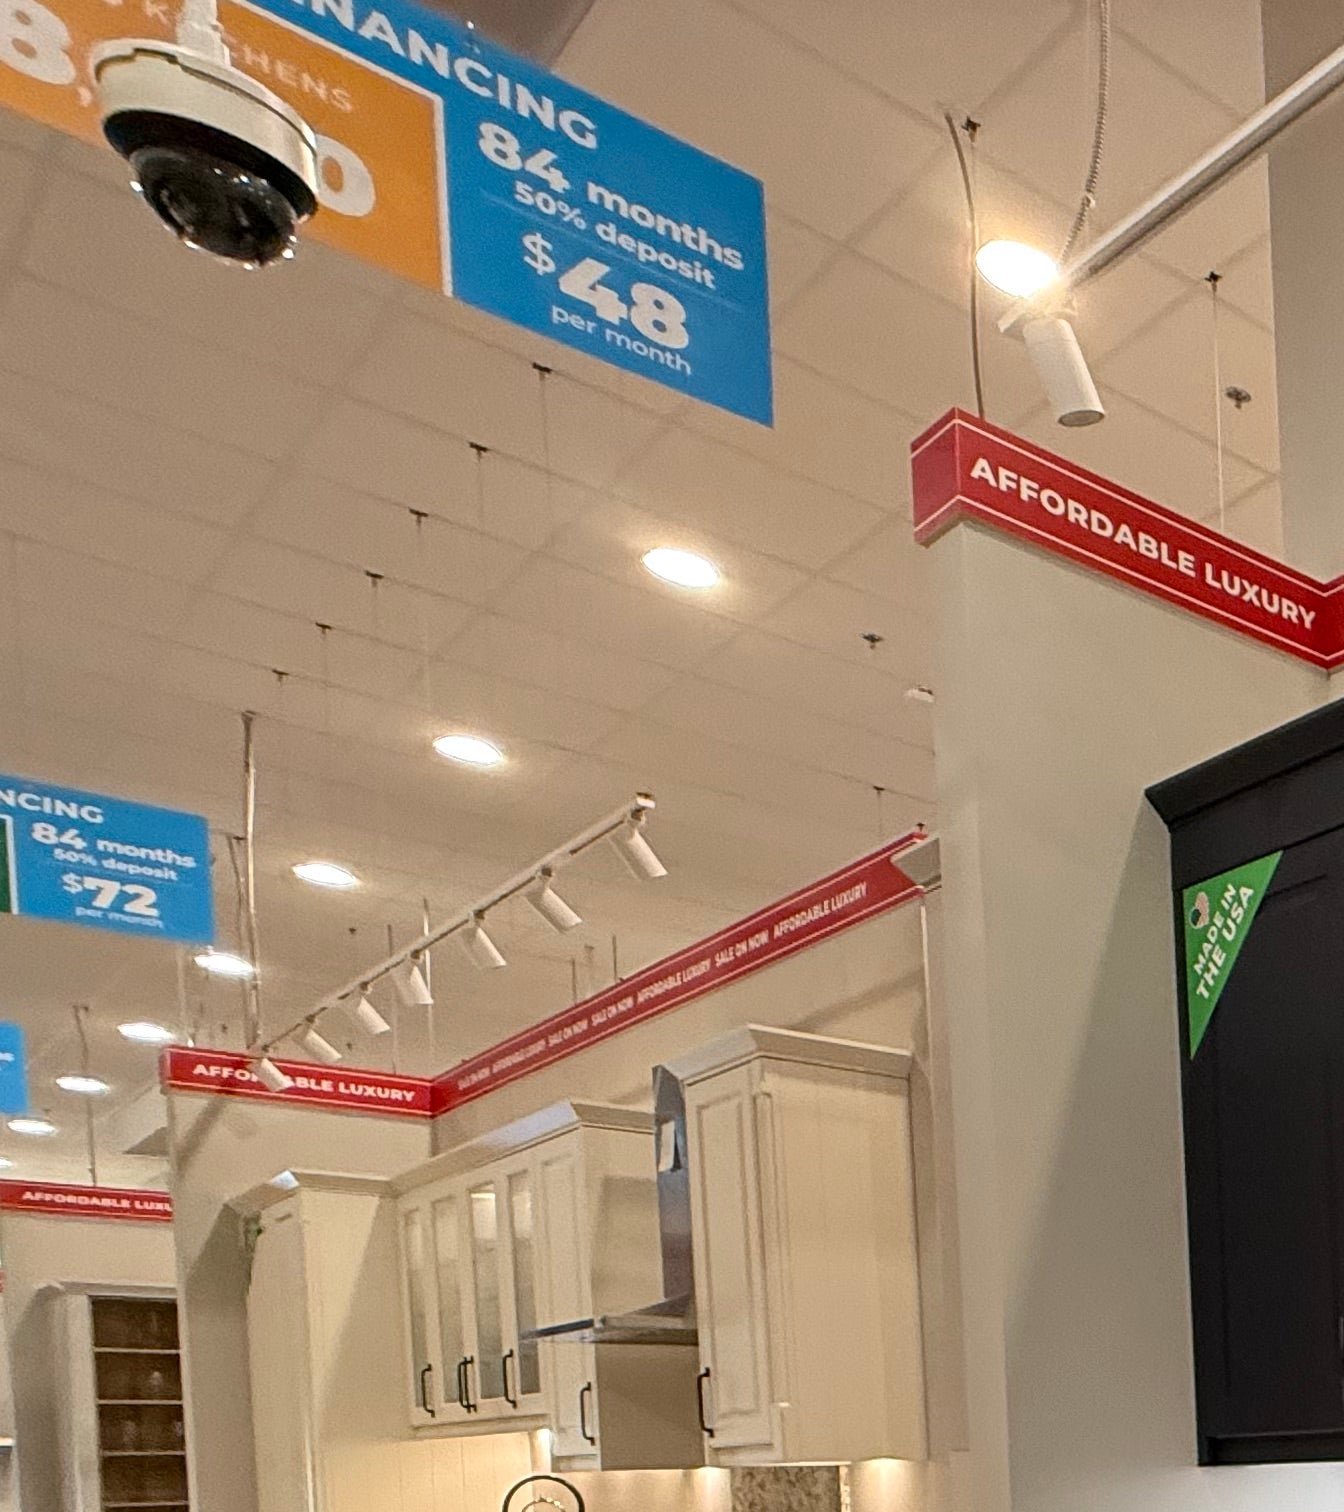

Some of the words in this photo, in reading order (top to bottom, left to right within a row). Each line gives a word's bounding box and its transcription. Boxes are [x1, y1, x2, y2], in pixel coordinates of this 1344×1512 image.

[479, 121, 571, 194] 84
[587, 181, 744, 271] months
[514, 180, 587, 231] 50%
[595, 221, 716, 290] deposit
[522, 232, 689, 349] $48
[552, 304, 597, 334] per
[605, 327, 692, 376] month
[970, 458, 1196, 577] AFFORDABLE
[1205, 562, 1316, 629] LUXURY
[31, 822, 88, 849] 84
[97, 839, 196, 868] months
[54, 848, 98, 866] 50%
[102, 858, 178, 881] deposit
[61, 872, 160, 917] $72
[773, 900, 830, 940] AFFORDABLE
[831, 882, 867, 911] LUXURY
[715, 948, 735, 969] SALE
[735, 941, 748, 956] ON
[749, 929, 769, 950] NOW
[1194, 911, 1225, 975] MADE
[1221, 883, 1237, 910] IN
[1196, 944, 1227, 999] THE
[1222, 886, 1254, 942] USA
[338, 1081, 415, 1102] LUXURY
[22, 1191, 131, 1209] AFFORDABLE
